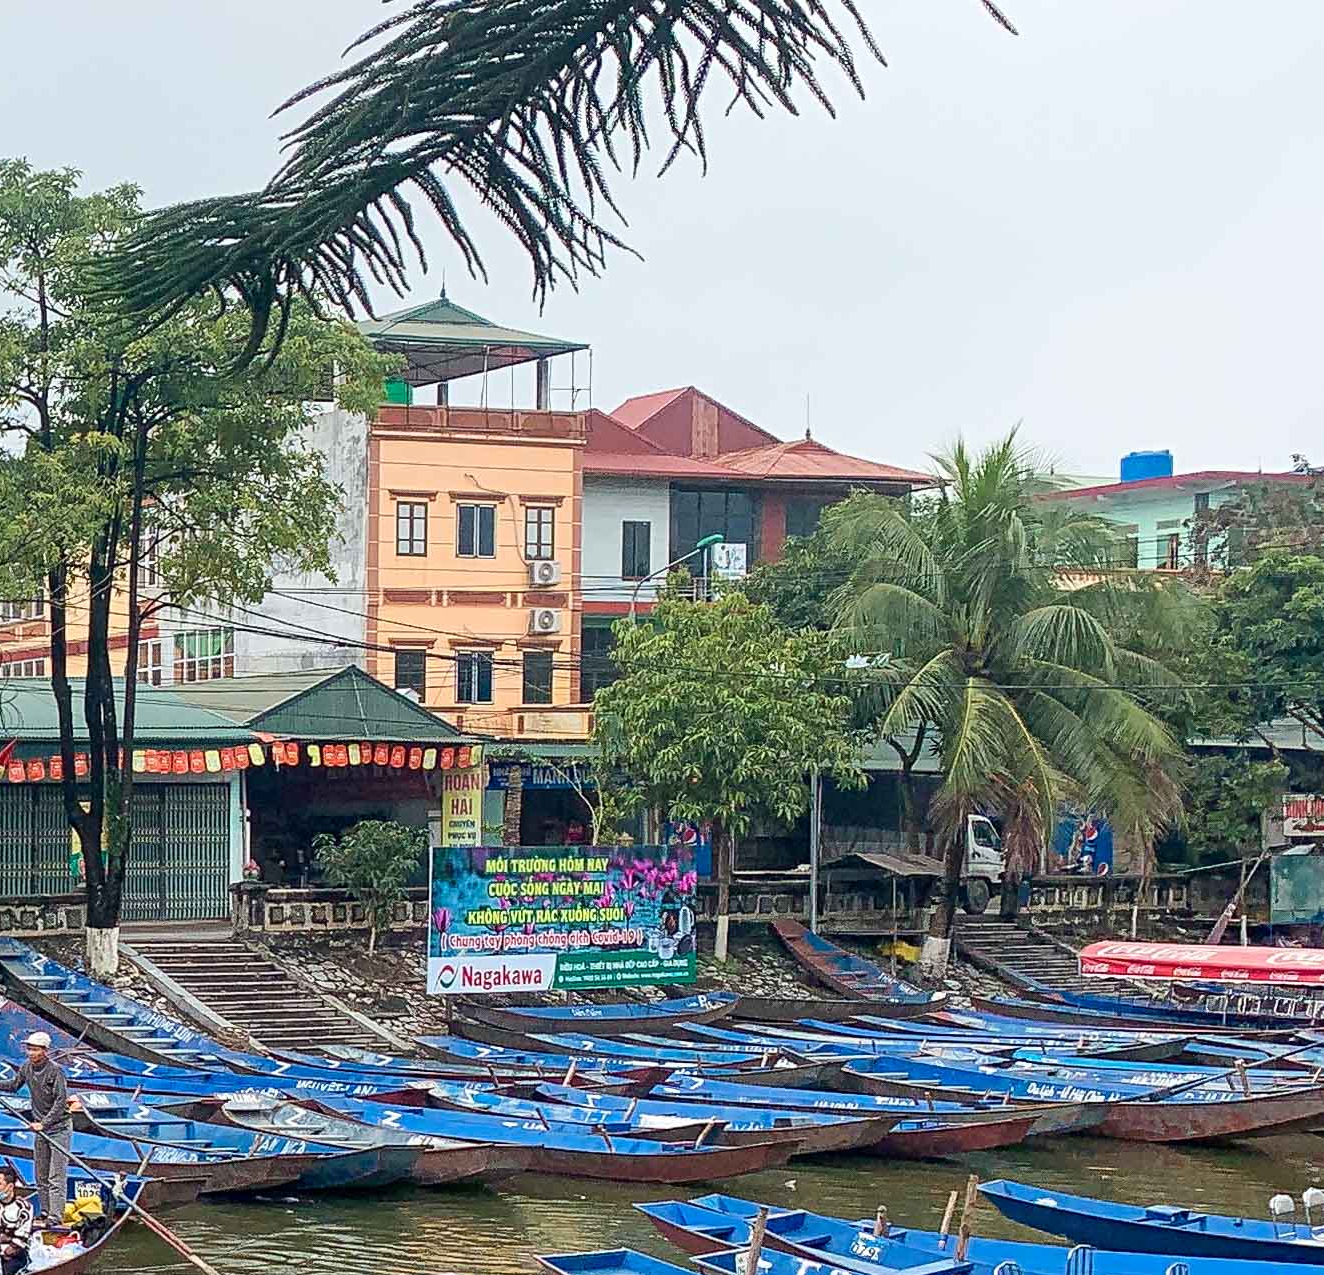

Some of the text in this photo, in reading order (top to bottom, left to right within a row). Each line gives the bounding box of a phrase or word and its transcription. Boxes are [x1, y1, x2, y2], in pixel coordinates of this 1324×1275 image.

[509, 855, 556, 872] TRƯỜNG
[558, 855, 585, 872] HÔM
[587, 857, 609, 871] NAY
[488, 878, 604, 897] CUỘC SỐNG NGÀY MAI
[468, 904, 625, 925] KHÔNG VỨT RÁC XUỐNG SUỐI
[504, 930, 535, 949] phòng
[462, 963, 542, 989] Nagakawa
